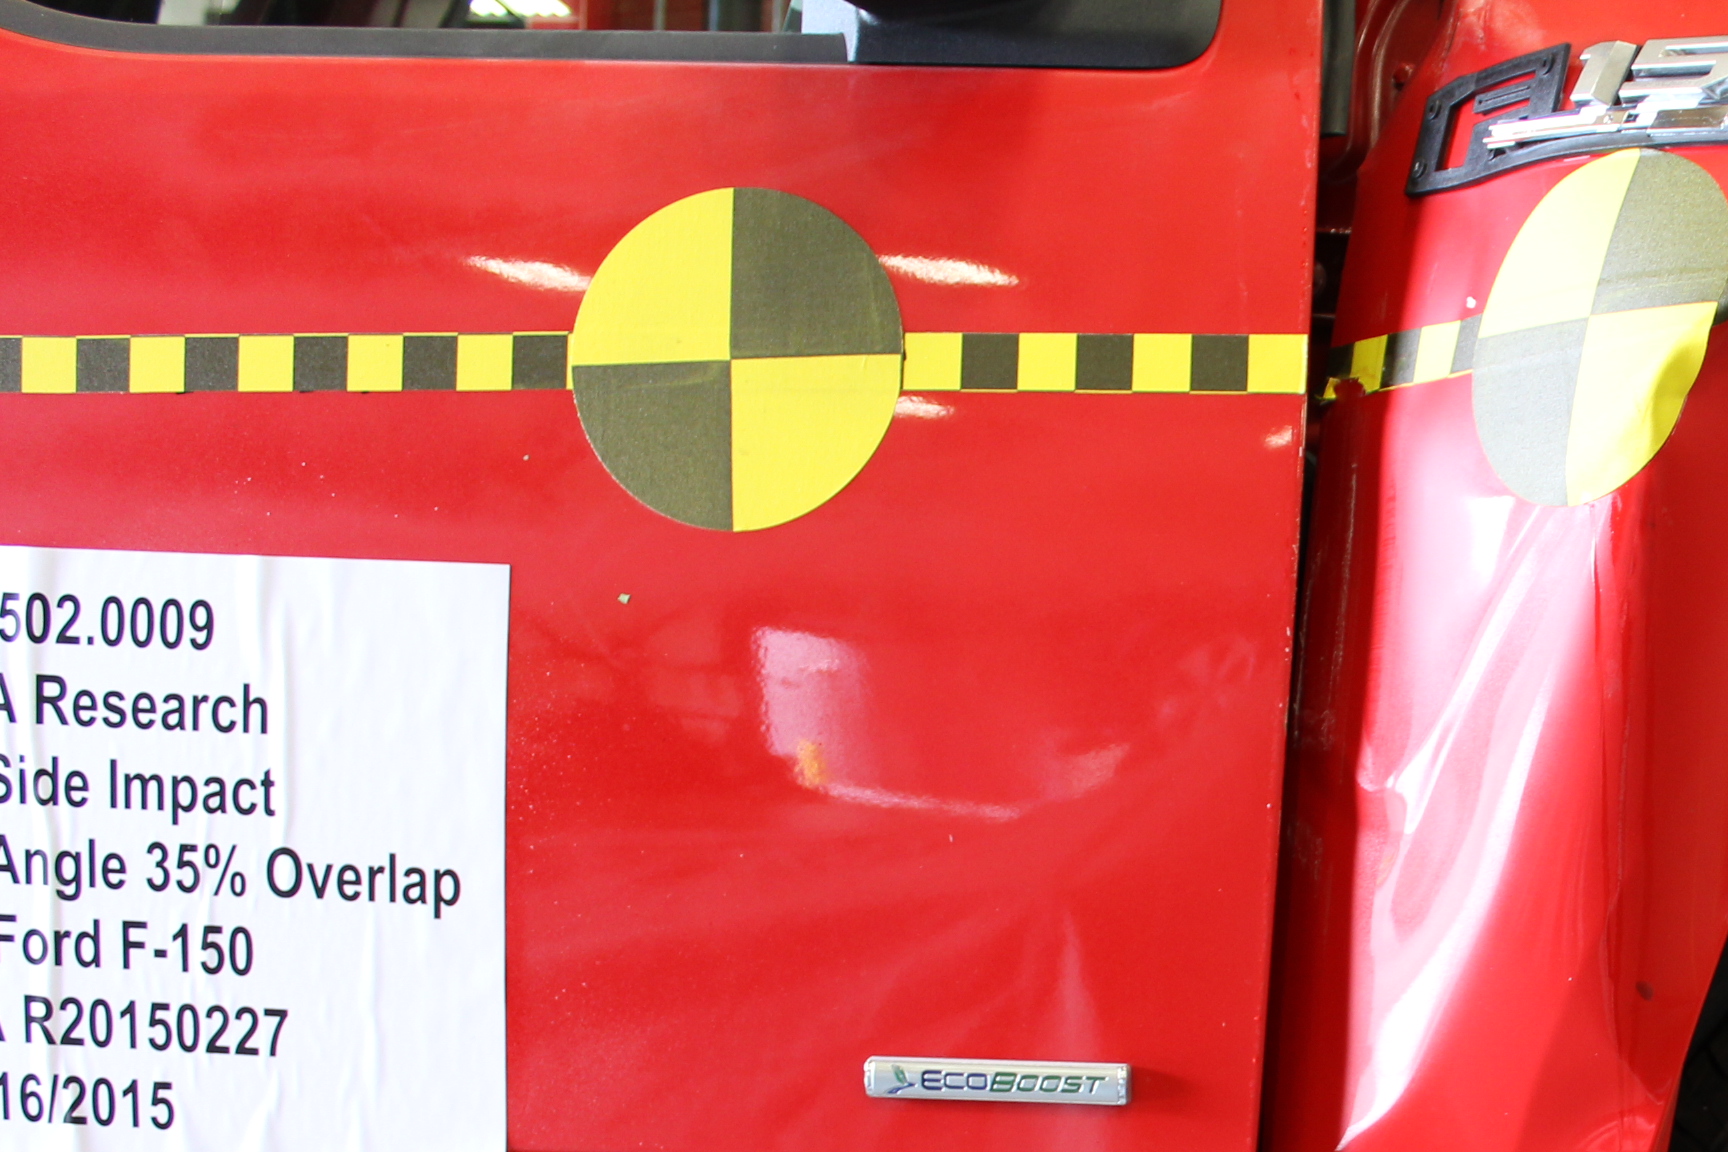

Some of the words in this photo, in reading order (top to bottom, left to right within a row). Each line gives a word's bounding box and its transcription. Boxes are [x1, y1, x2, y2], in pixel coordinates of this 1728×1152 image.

[36, 674, 267, 734] Research
[110, 759, 275, 825] Impact
[147, 842, 246, 896] 35%
[267, 847, 460, 919] Overlap
[123, 921, 253, 976] F-150
[24, 995, 287, 1056] R20150227
